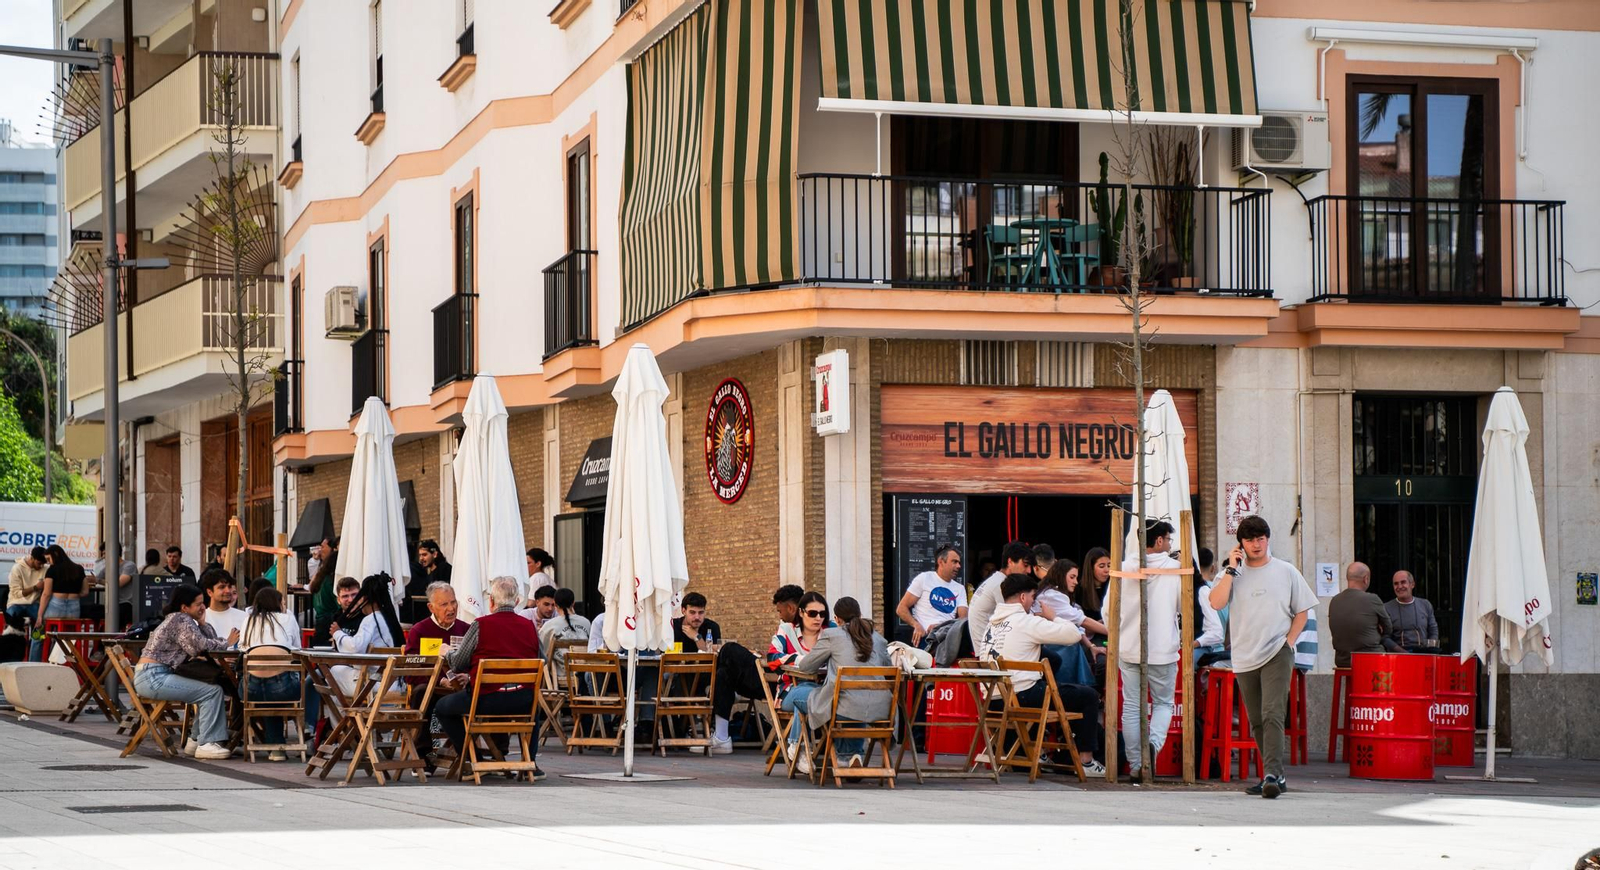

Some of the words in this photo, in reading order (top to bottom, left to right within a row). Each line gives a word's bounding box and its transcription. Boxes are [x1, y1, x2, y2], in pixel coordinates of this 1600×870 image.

[709, 407, 717, 422] EL
[715, 384, 731, 405] GALLO
[732, 385, 747, 415] NEGRO
[943, 421, 972, 457] EL
[978, 422, 1052, 459] GALLO
[1059, 423, 1135, 460] NEGRO
[709, 467, 719, 490] LA
[719, 461, 748, 499] MERCED
[1395, 479, 1412, 496] 10
[931, 594, 955, 608] NASA
